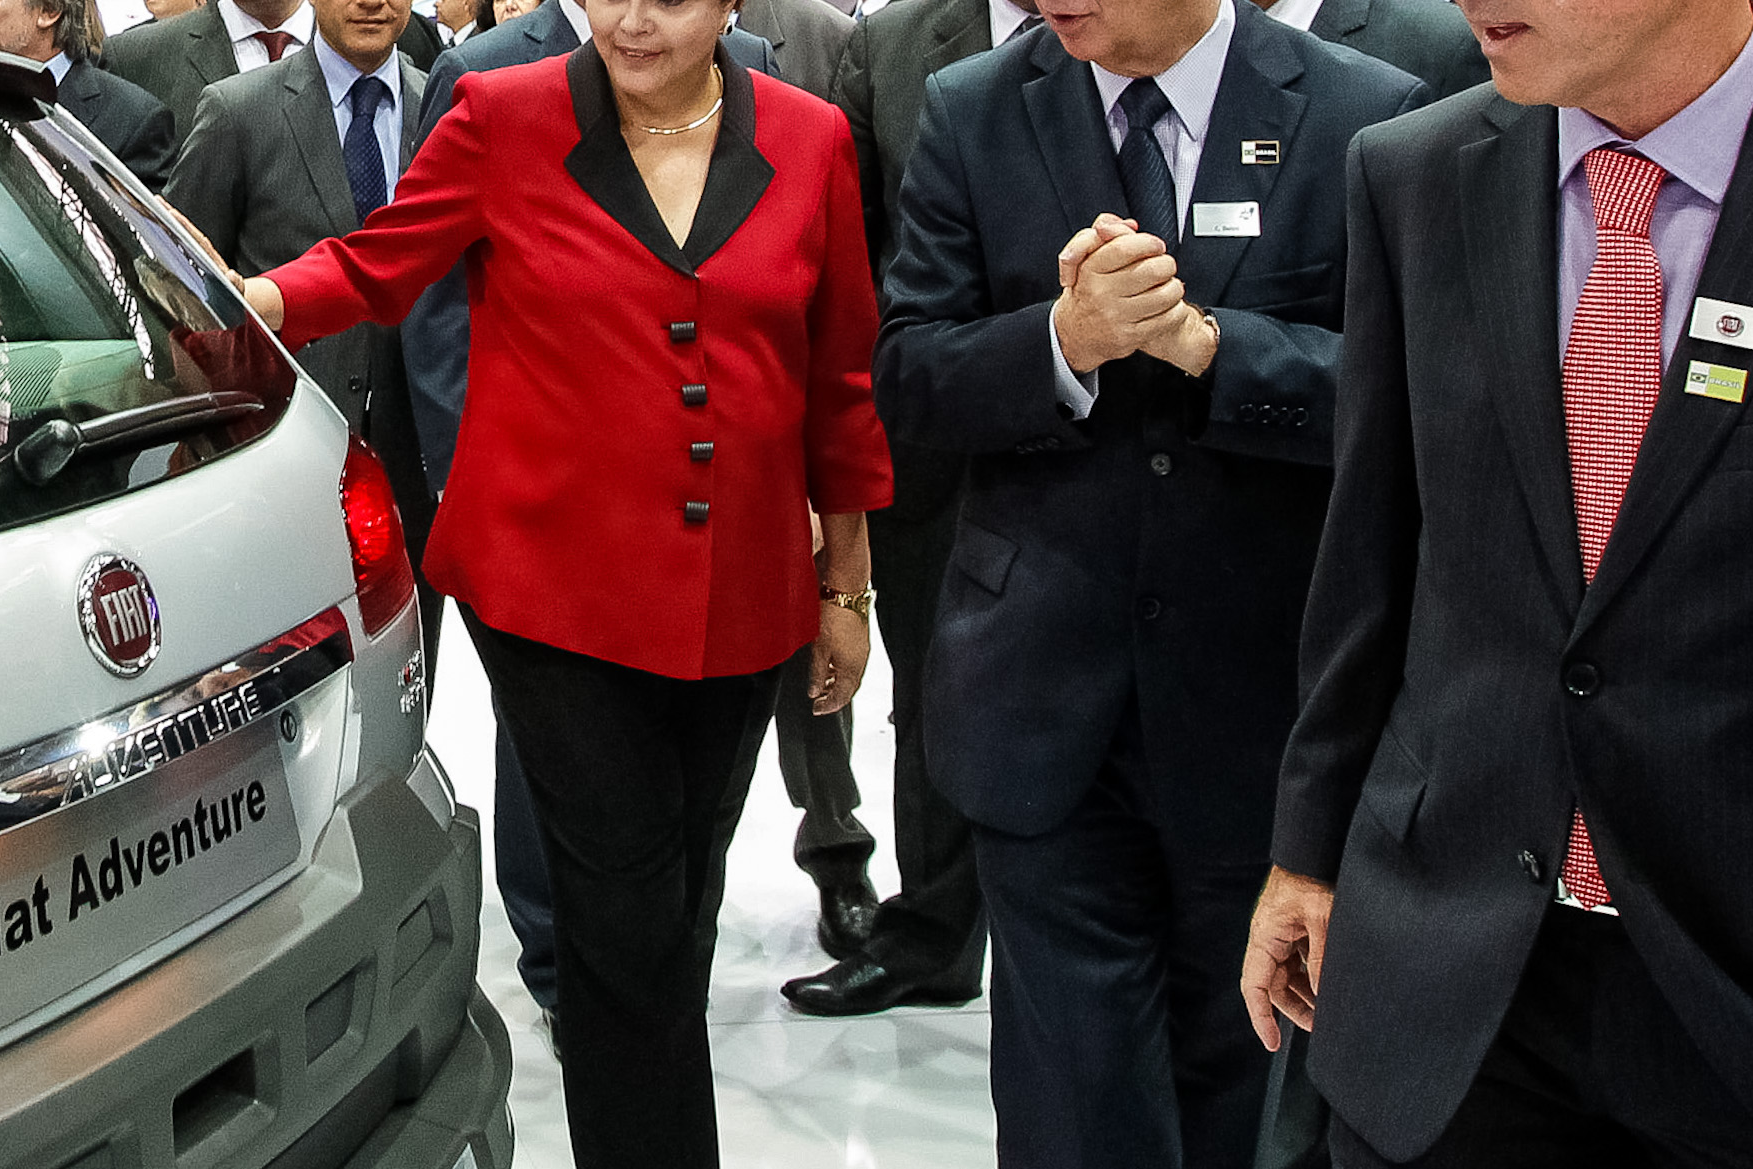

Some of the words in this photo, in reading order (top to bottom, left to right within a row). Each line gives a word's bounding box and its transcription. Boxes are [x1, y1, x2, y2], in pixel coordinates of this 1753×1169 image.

[99, 583, 147, 646] FIAT
[60, 680, 263, 807] ADVENTURE
[68, 780, 267, 923] Adventure
